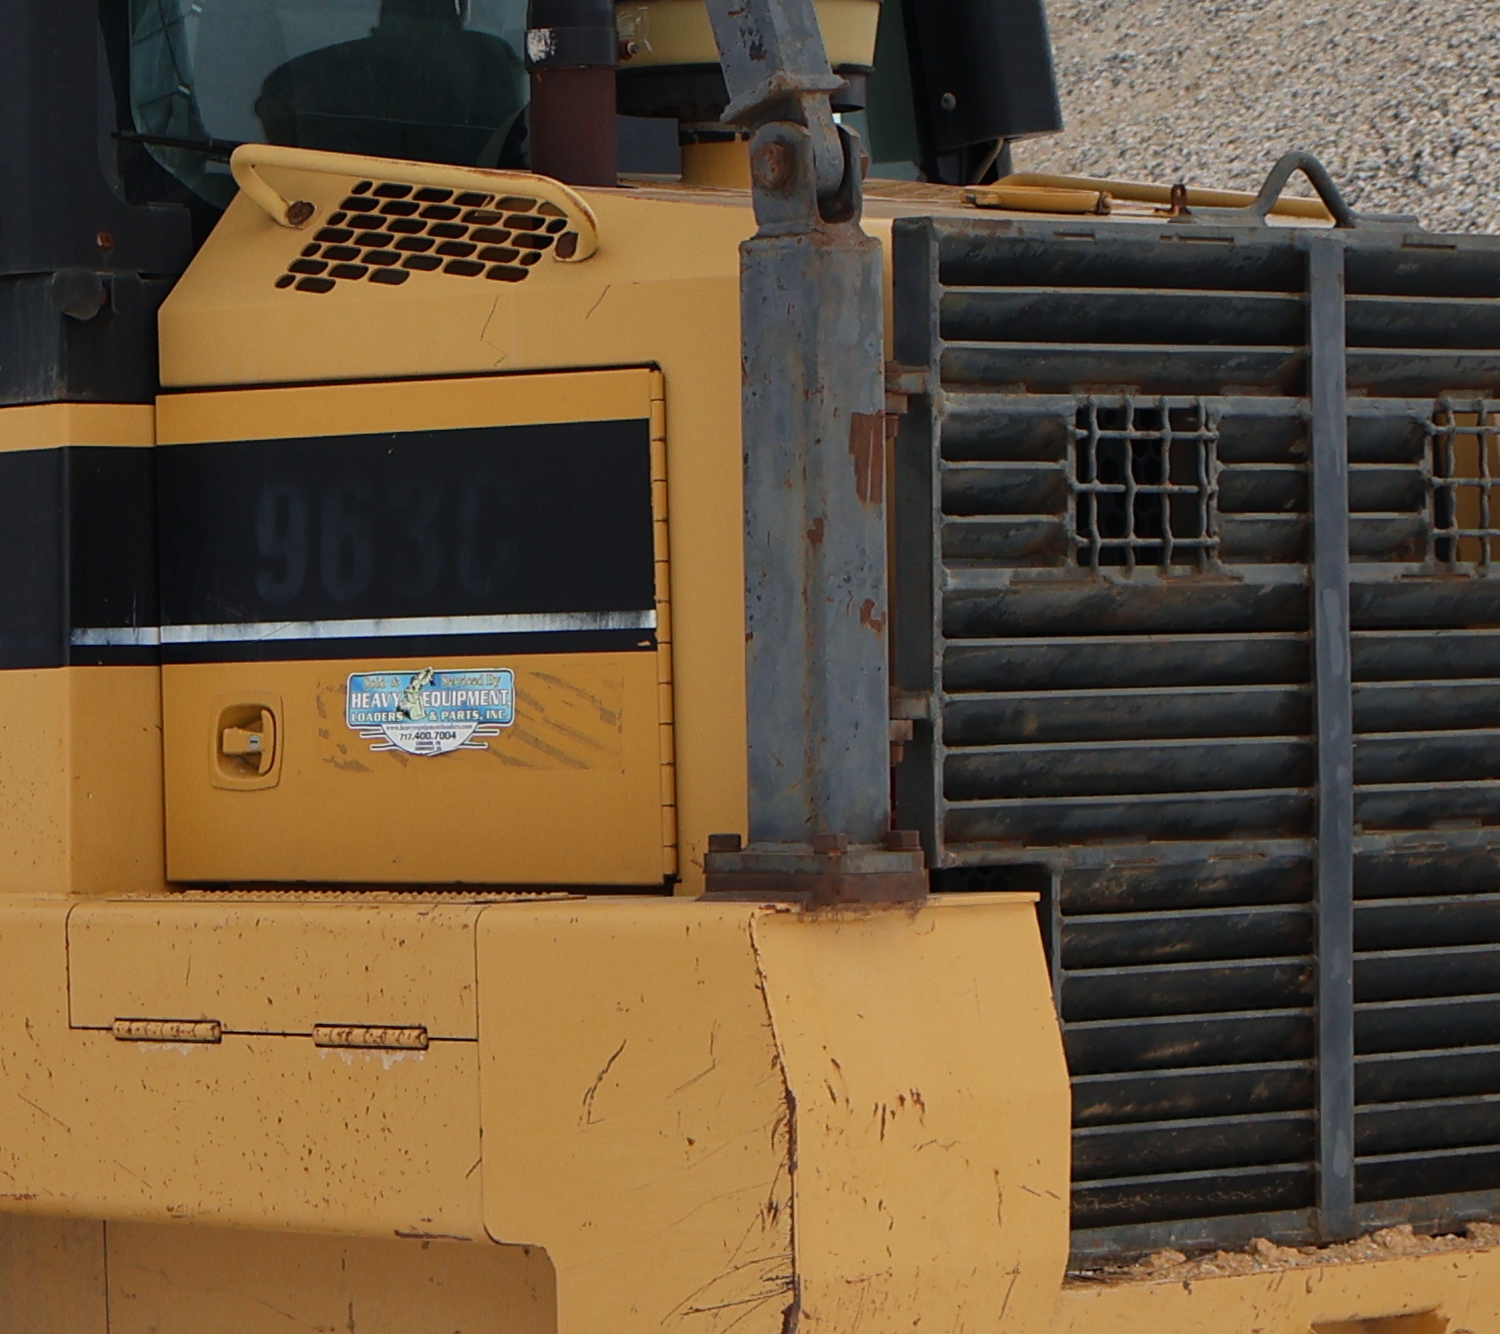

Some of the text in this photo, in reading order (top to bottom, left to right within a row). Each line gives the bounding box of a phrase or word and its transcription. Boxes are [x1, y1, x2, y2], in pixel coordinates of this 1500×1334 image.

[351, 692, 401, 709] HEAVY
[351, 712, 404, 722] LOADERS
[429, 711, 438, 721] &
[486, 709, 510, 720] INC.
